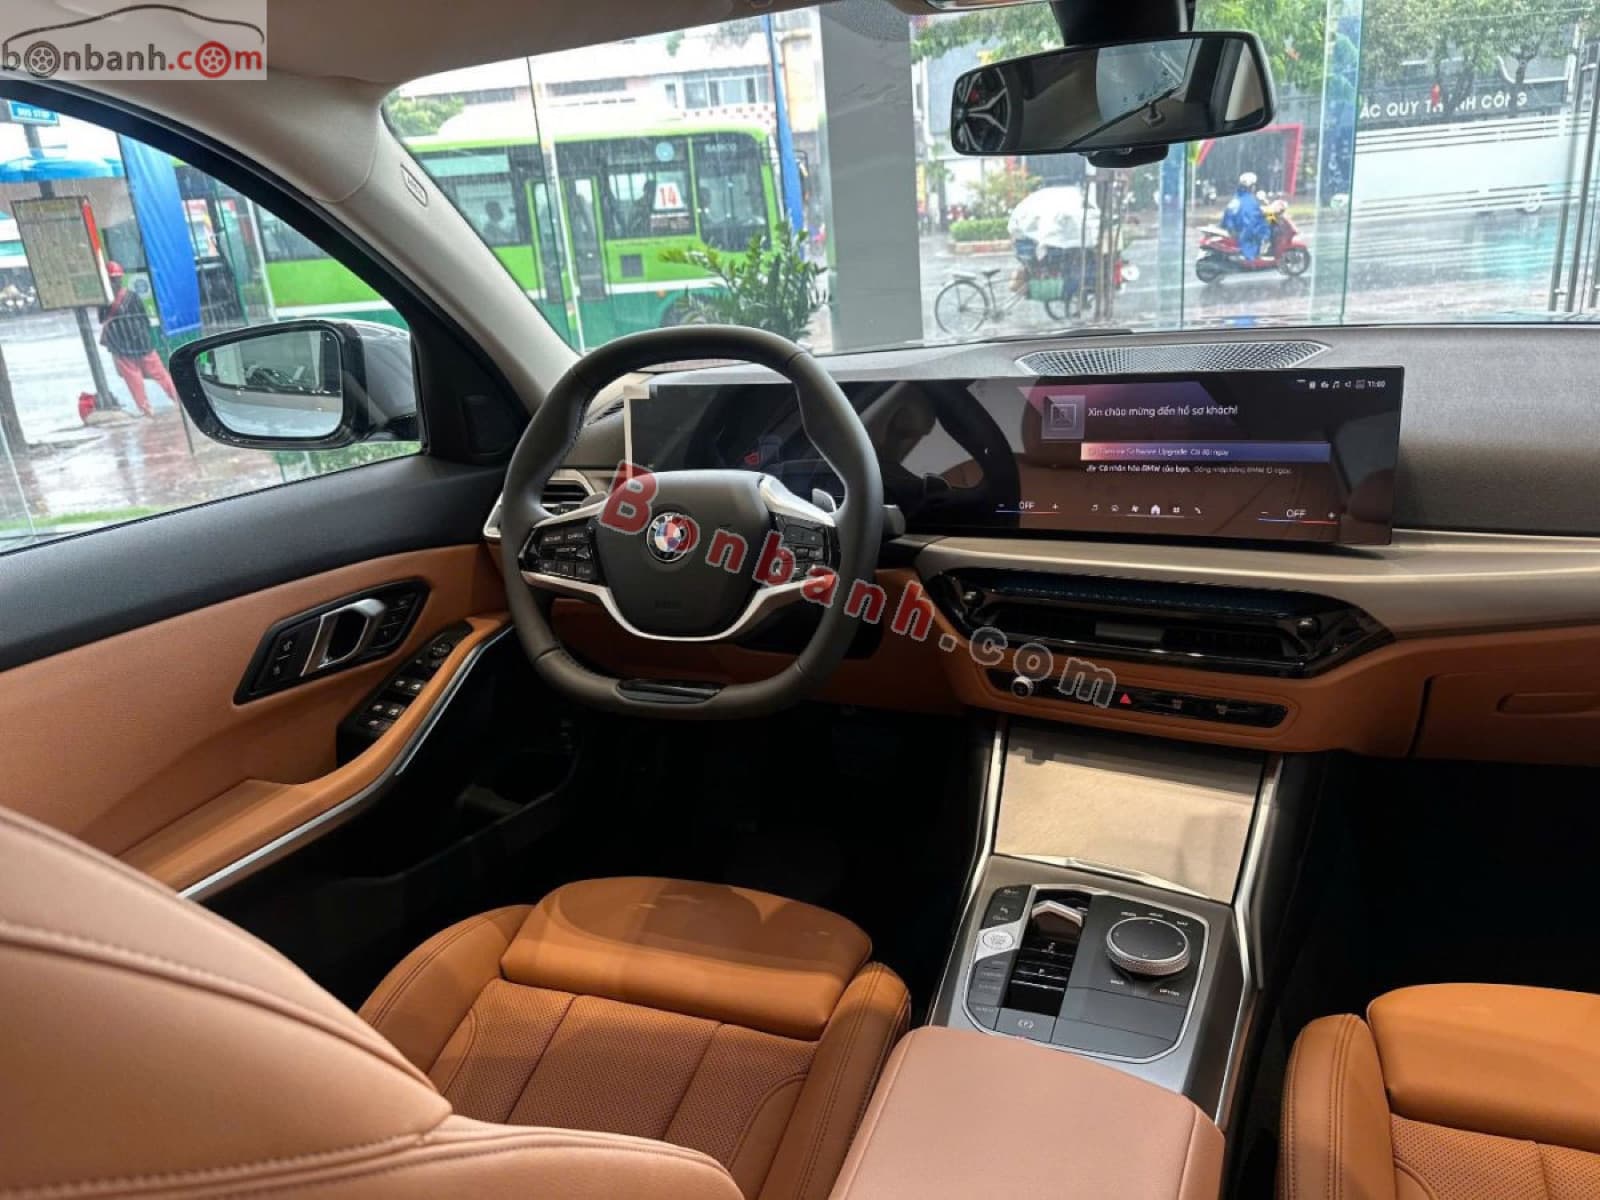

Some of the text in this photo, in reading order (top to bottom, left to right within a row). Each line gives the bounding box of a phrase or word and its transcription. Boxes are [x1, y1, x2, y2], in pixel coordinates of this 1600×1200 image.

[659, 186, 677, 206] 14
[1087, 407, 1103, 417] Xin
[1018, 500, 1036, 510] OFF
[1286, 508, 1307, 518] OFF
